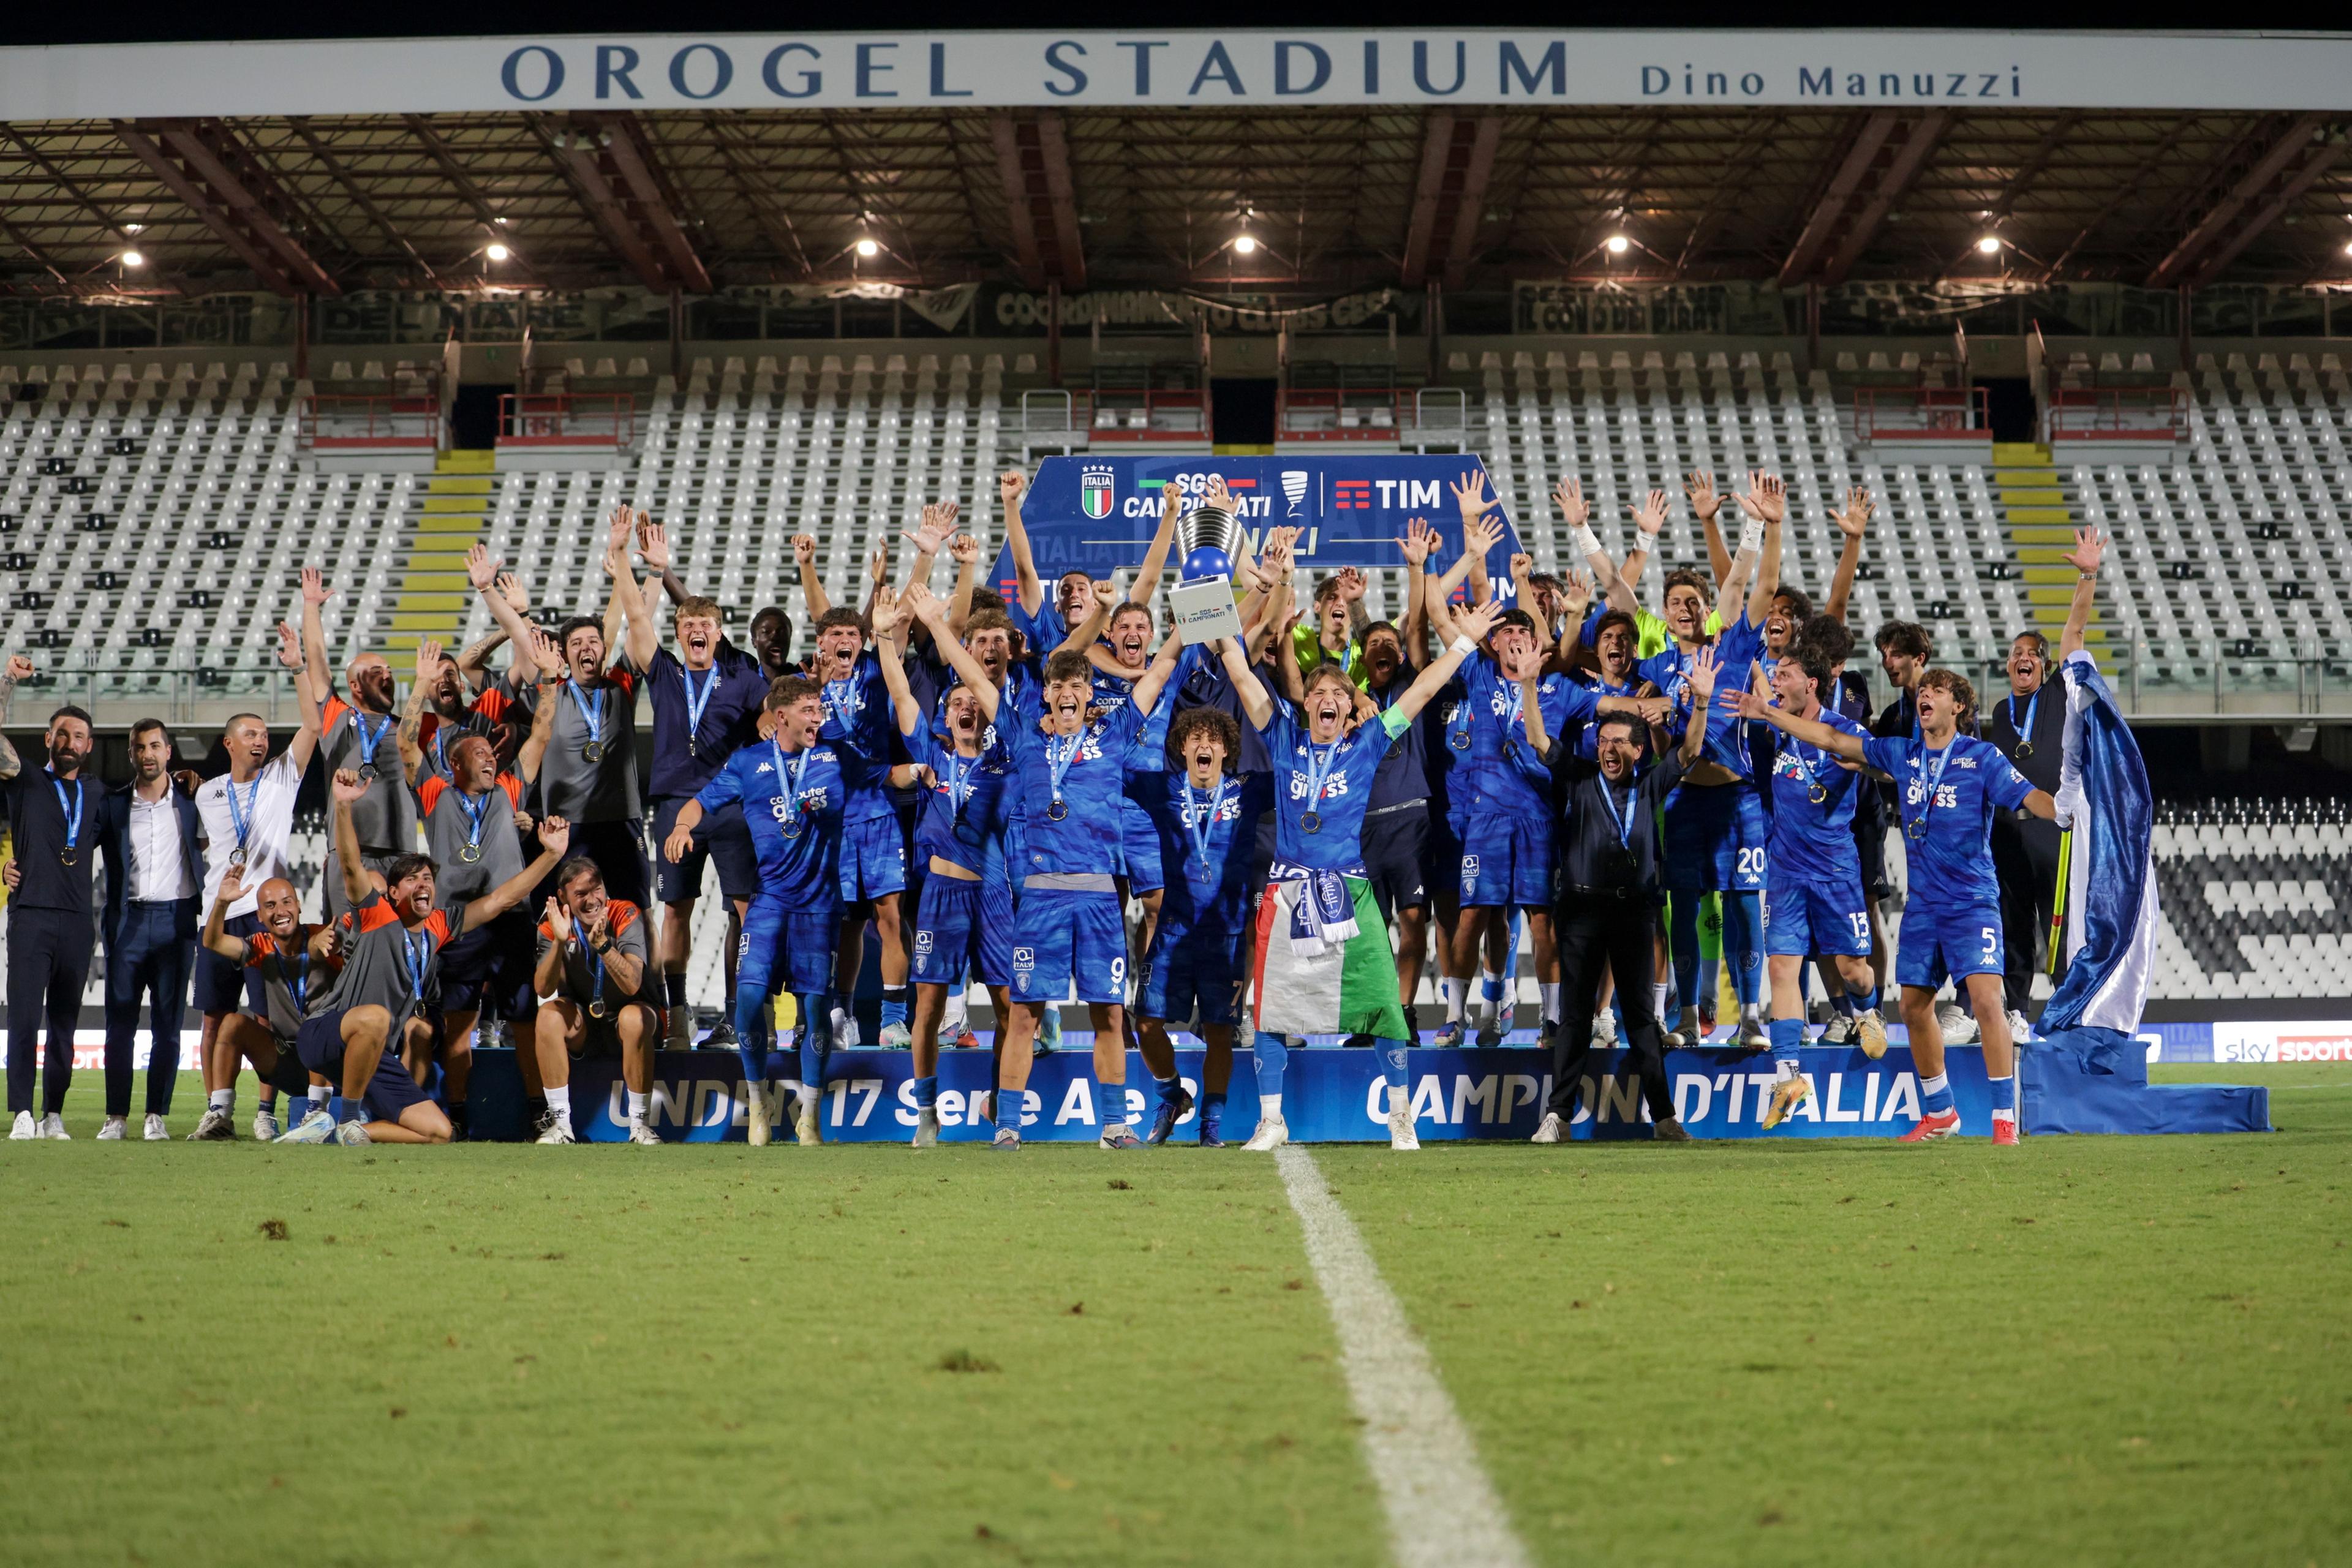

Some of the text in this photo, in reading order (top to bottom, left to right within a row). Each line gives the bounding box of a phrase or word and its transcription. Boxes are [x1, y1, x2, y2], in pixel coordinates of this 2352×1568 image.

[500, 39, 2021, 102] OROGEL STADIUM Dino Manuzzi
[1085, 477, 1110, 486] ITALIA
[1175, 473, 1222, 494] SGS
[1376, 480, 1440, 508] TIM
[1188, 611, 1225, 623] CAMPIONATI
[1737, 847, 1765, 873] 20
[1849, 911, 1869, 938] 13
[1981, 927, 1996, 953] 5
[1111, 957, 1125, 984] 9
[1231, 980, 1243, 1006] 7
[2225, 1038, 2270, 1062] sky
[2281, 1038, 2352, 1062] sport
[829, 1079, 883, 1127] 17
[894, 1078, 1041, 1126] Sere
[1054, 1077, 1096, 1125] A
[1675, 1072, 1923, 1123] D'ITALIA
